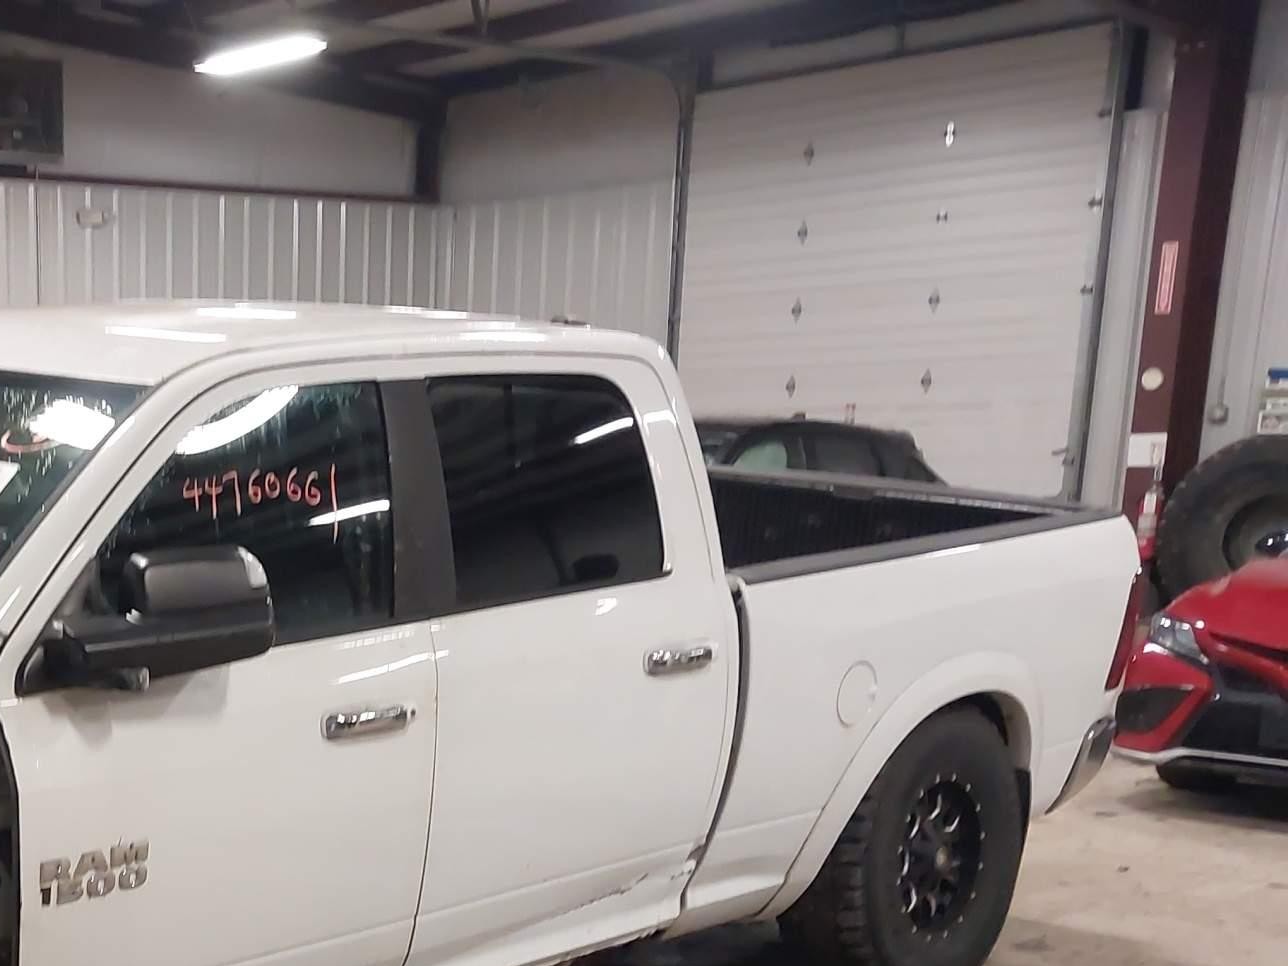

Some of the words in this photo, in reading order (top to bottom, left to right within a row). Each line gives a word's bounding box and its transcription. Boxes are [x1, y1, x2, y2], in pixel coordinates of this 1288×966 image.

[182, 463, 340, 544] 44760661
[39, 838, 150, 886] RAM
[39, 864, 148, 905] 1500
